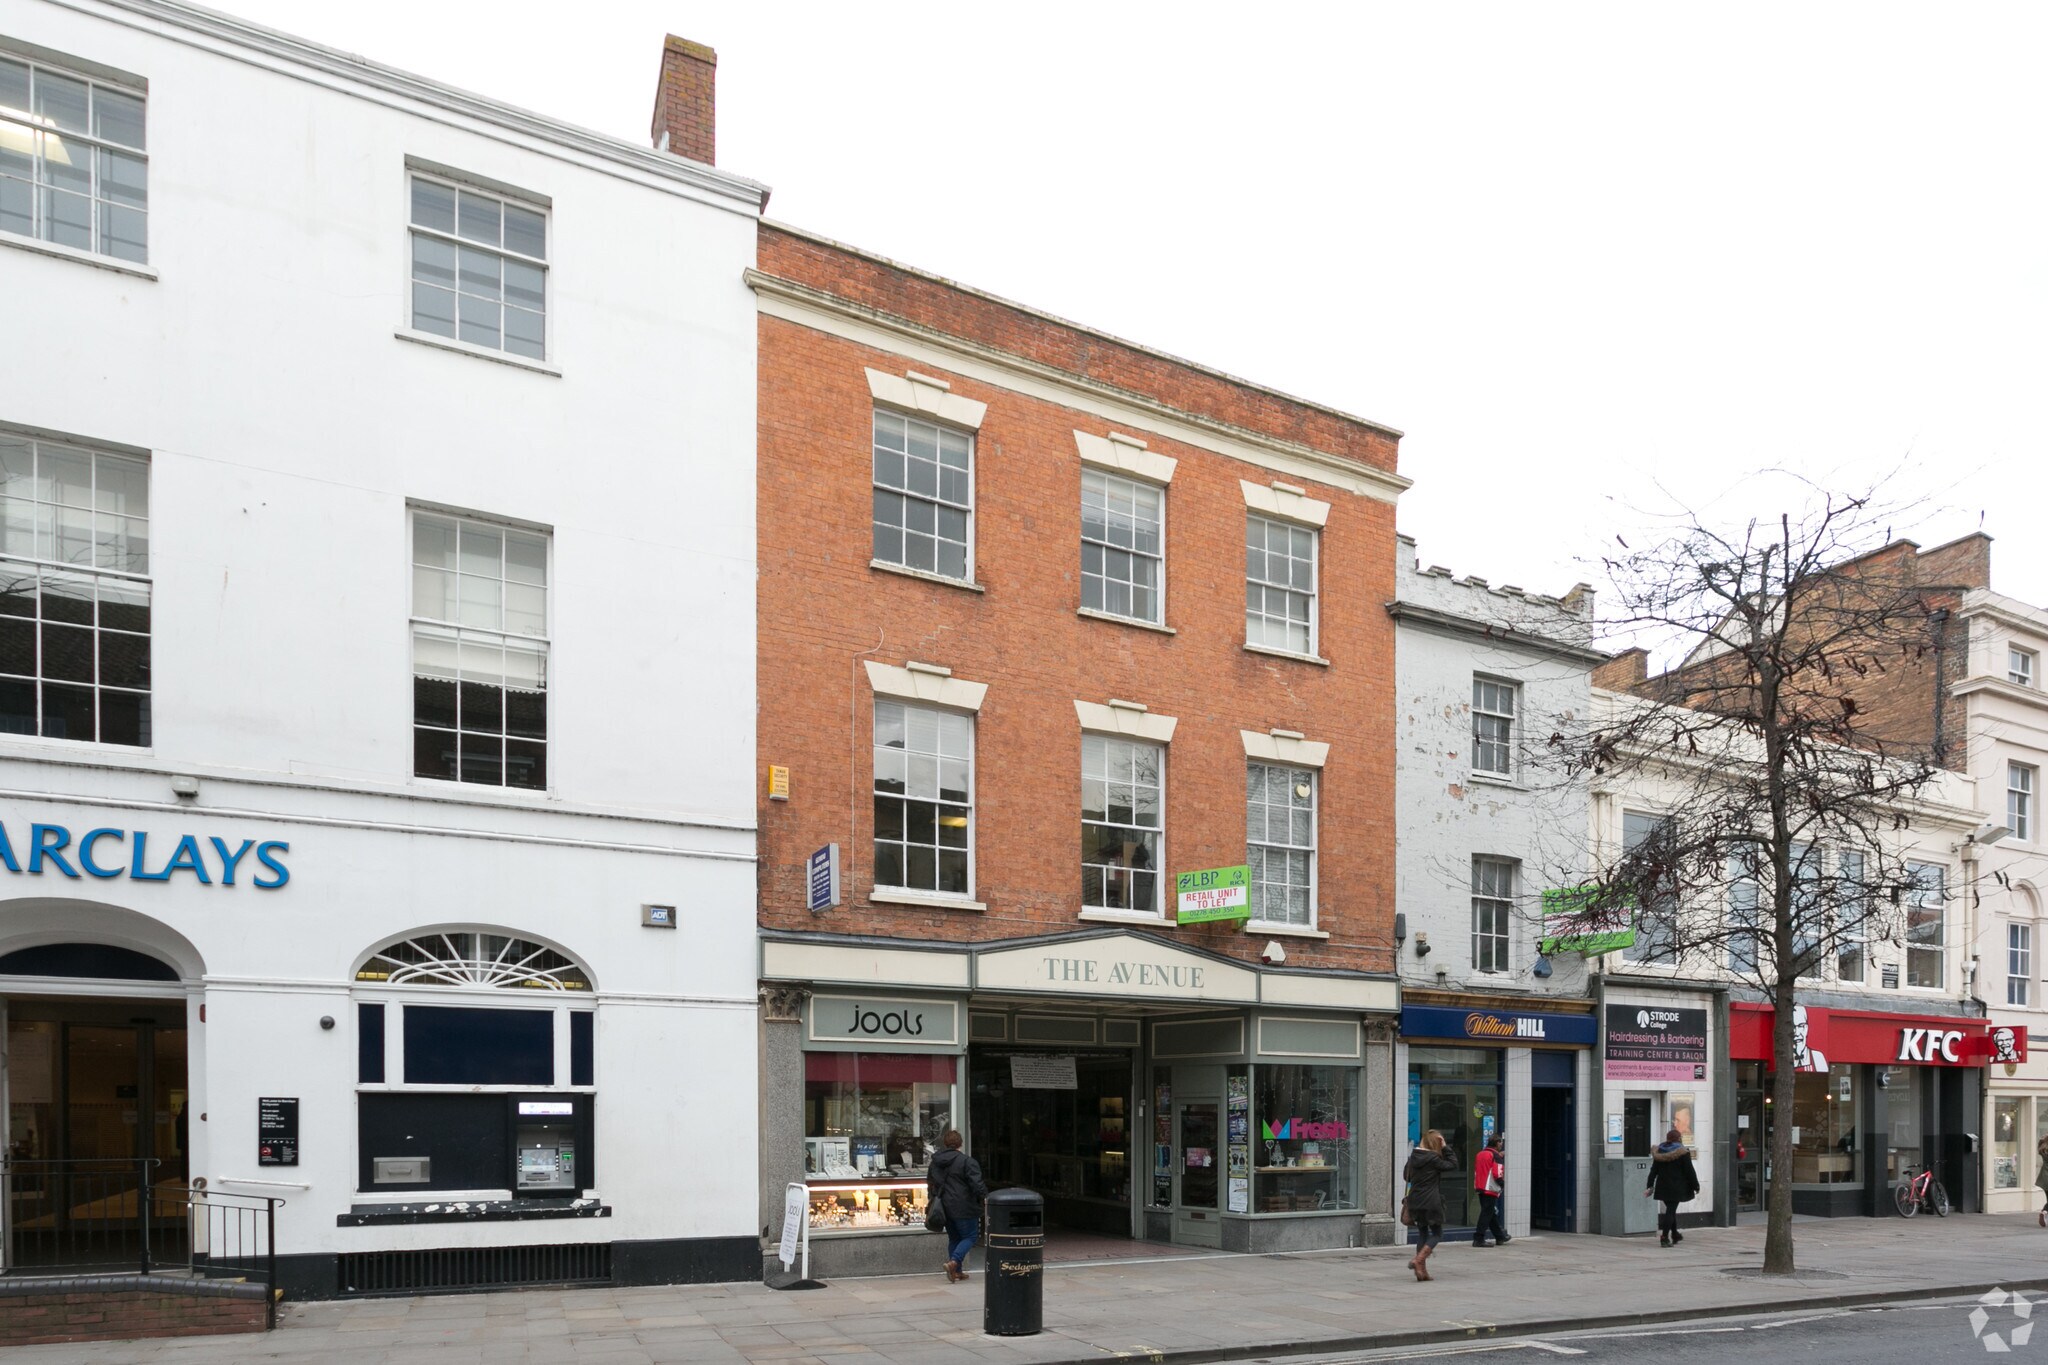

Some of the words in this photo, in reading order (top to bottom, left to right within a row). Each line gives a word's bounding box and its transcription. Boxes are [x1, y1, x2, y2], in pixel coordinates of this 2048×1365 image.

[1192, 871, 1219, 887] LBP
[1186, 891, 1214, 902] RETAIL
[1218, 888, 1238, 898] UNIT
[1197, 900, 1208, 909] TO
[1211, 898, 1227, 907] LET
[652, 911, 666, 920] ADT
[1043, 957, 1099, 982] THE
[1107, 962, 1205, 989] AVENUE
[848, 1004, 923, 1035] jools
[1464, 1012, 1517, 1037] William
[1517, 1017, 1545, 1037] HILL
[1650, 1011, 1680, 1022] STRODE
[1609, 1031, 1658, 1046] Hairdressing
[1660, 1033, 1666, 1043] &
[1667, 1033, 1705, 1047] Barbering
[1899, 1028, 1962, 1062] KFC
[1609, 1049, 1644, 1058] TRAINING
[1646, 1050, 1673, 1059] CENTRE
[1675, 1051, 1680, 1059] &
[1682, 1052, 1704, 1060] SALON
[1290, 1117, 1348, 1139] Fresh
[1016, 1238, 1040, 1246] LITTER
